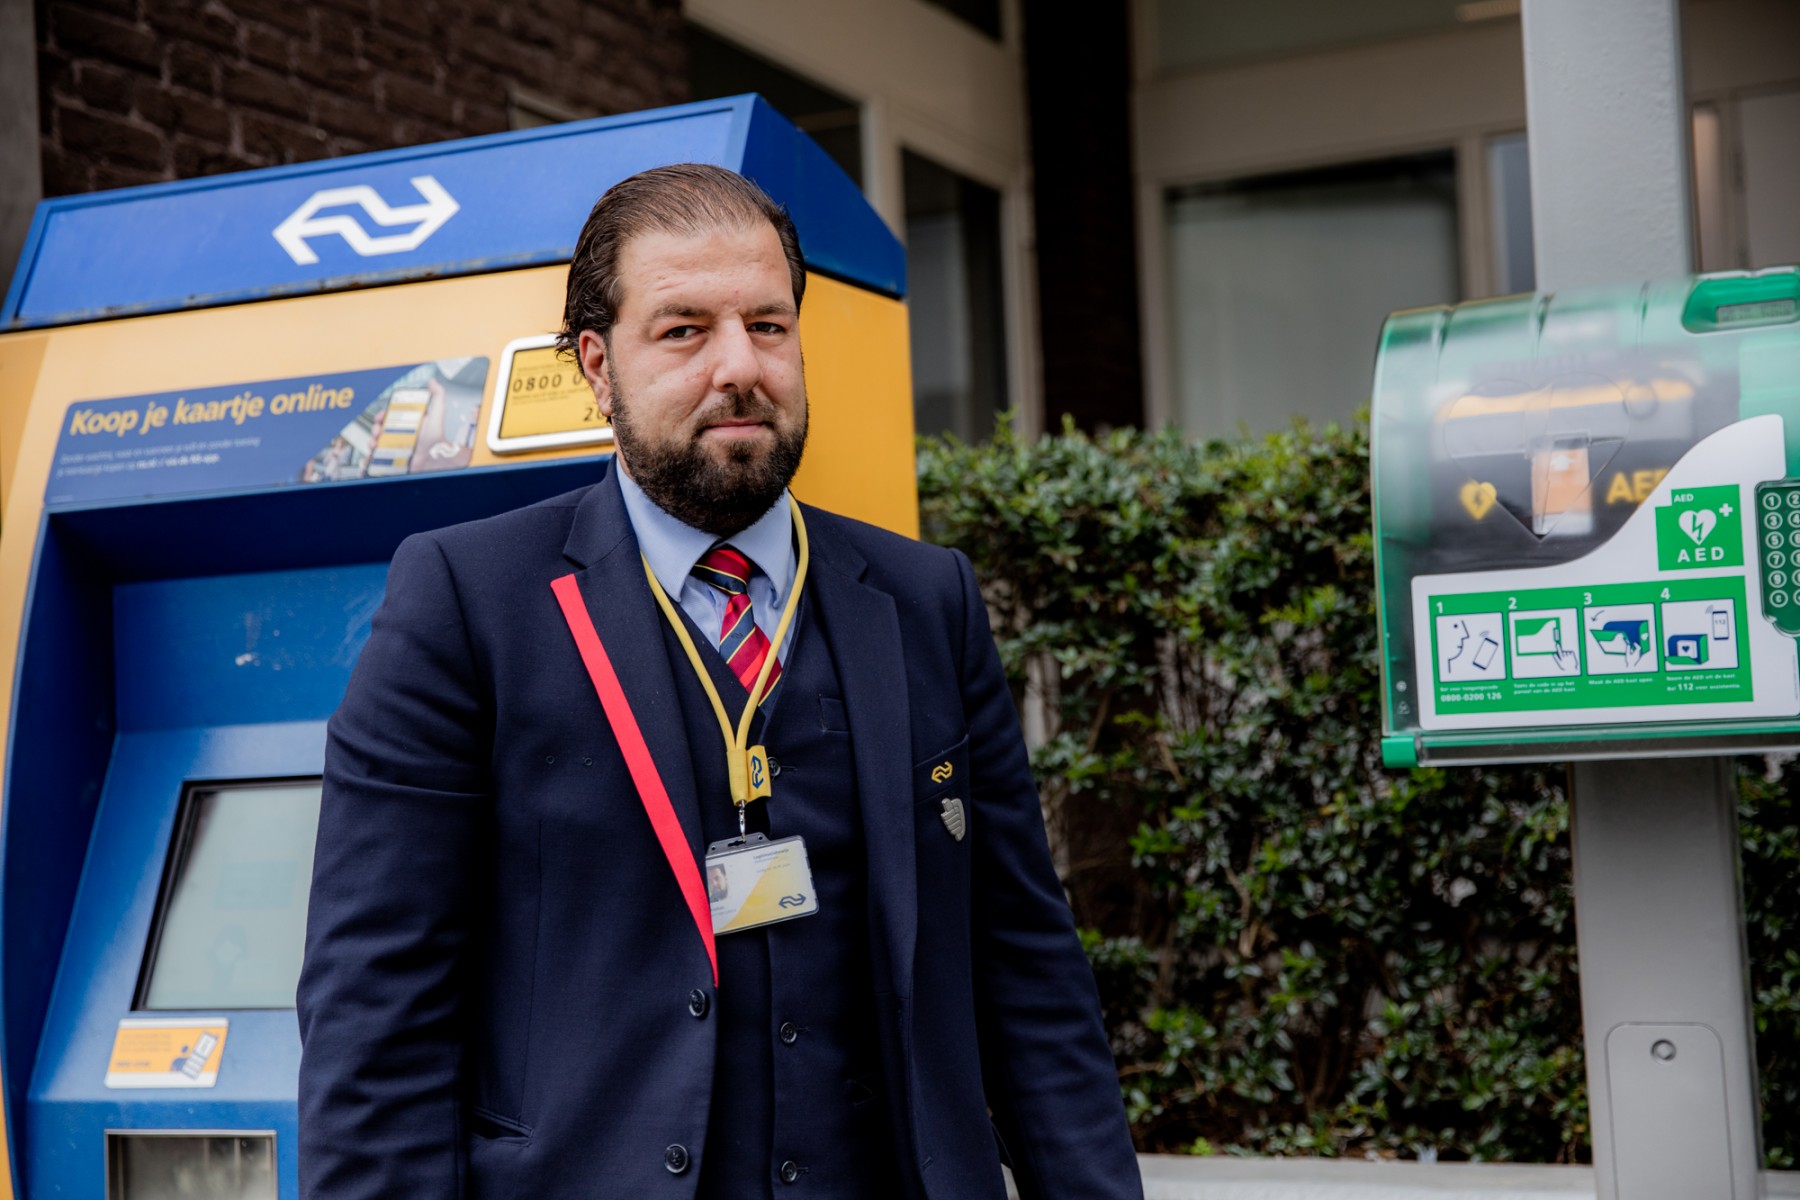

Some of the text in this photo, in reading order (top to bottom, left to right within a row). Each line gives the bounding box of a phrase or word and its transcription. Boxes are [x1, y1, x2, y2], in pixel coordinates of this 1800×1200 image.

[512, 374, 562, 393] 0800
[70, 384, 355, 437] Koop je kaartje online
[1674, 493, 1695, 503] AED
[1677, 546, 1725, 563] AED
[1583, 592, 1592, 605] 3
[1660, 587, 1671, 600] 4
[1436, 601, 1444, 614] 1
[1508, 597, 1517, 609] 2
[1678, 683, 1694, 691] 112
